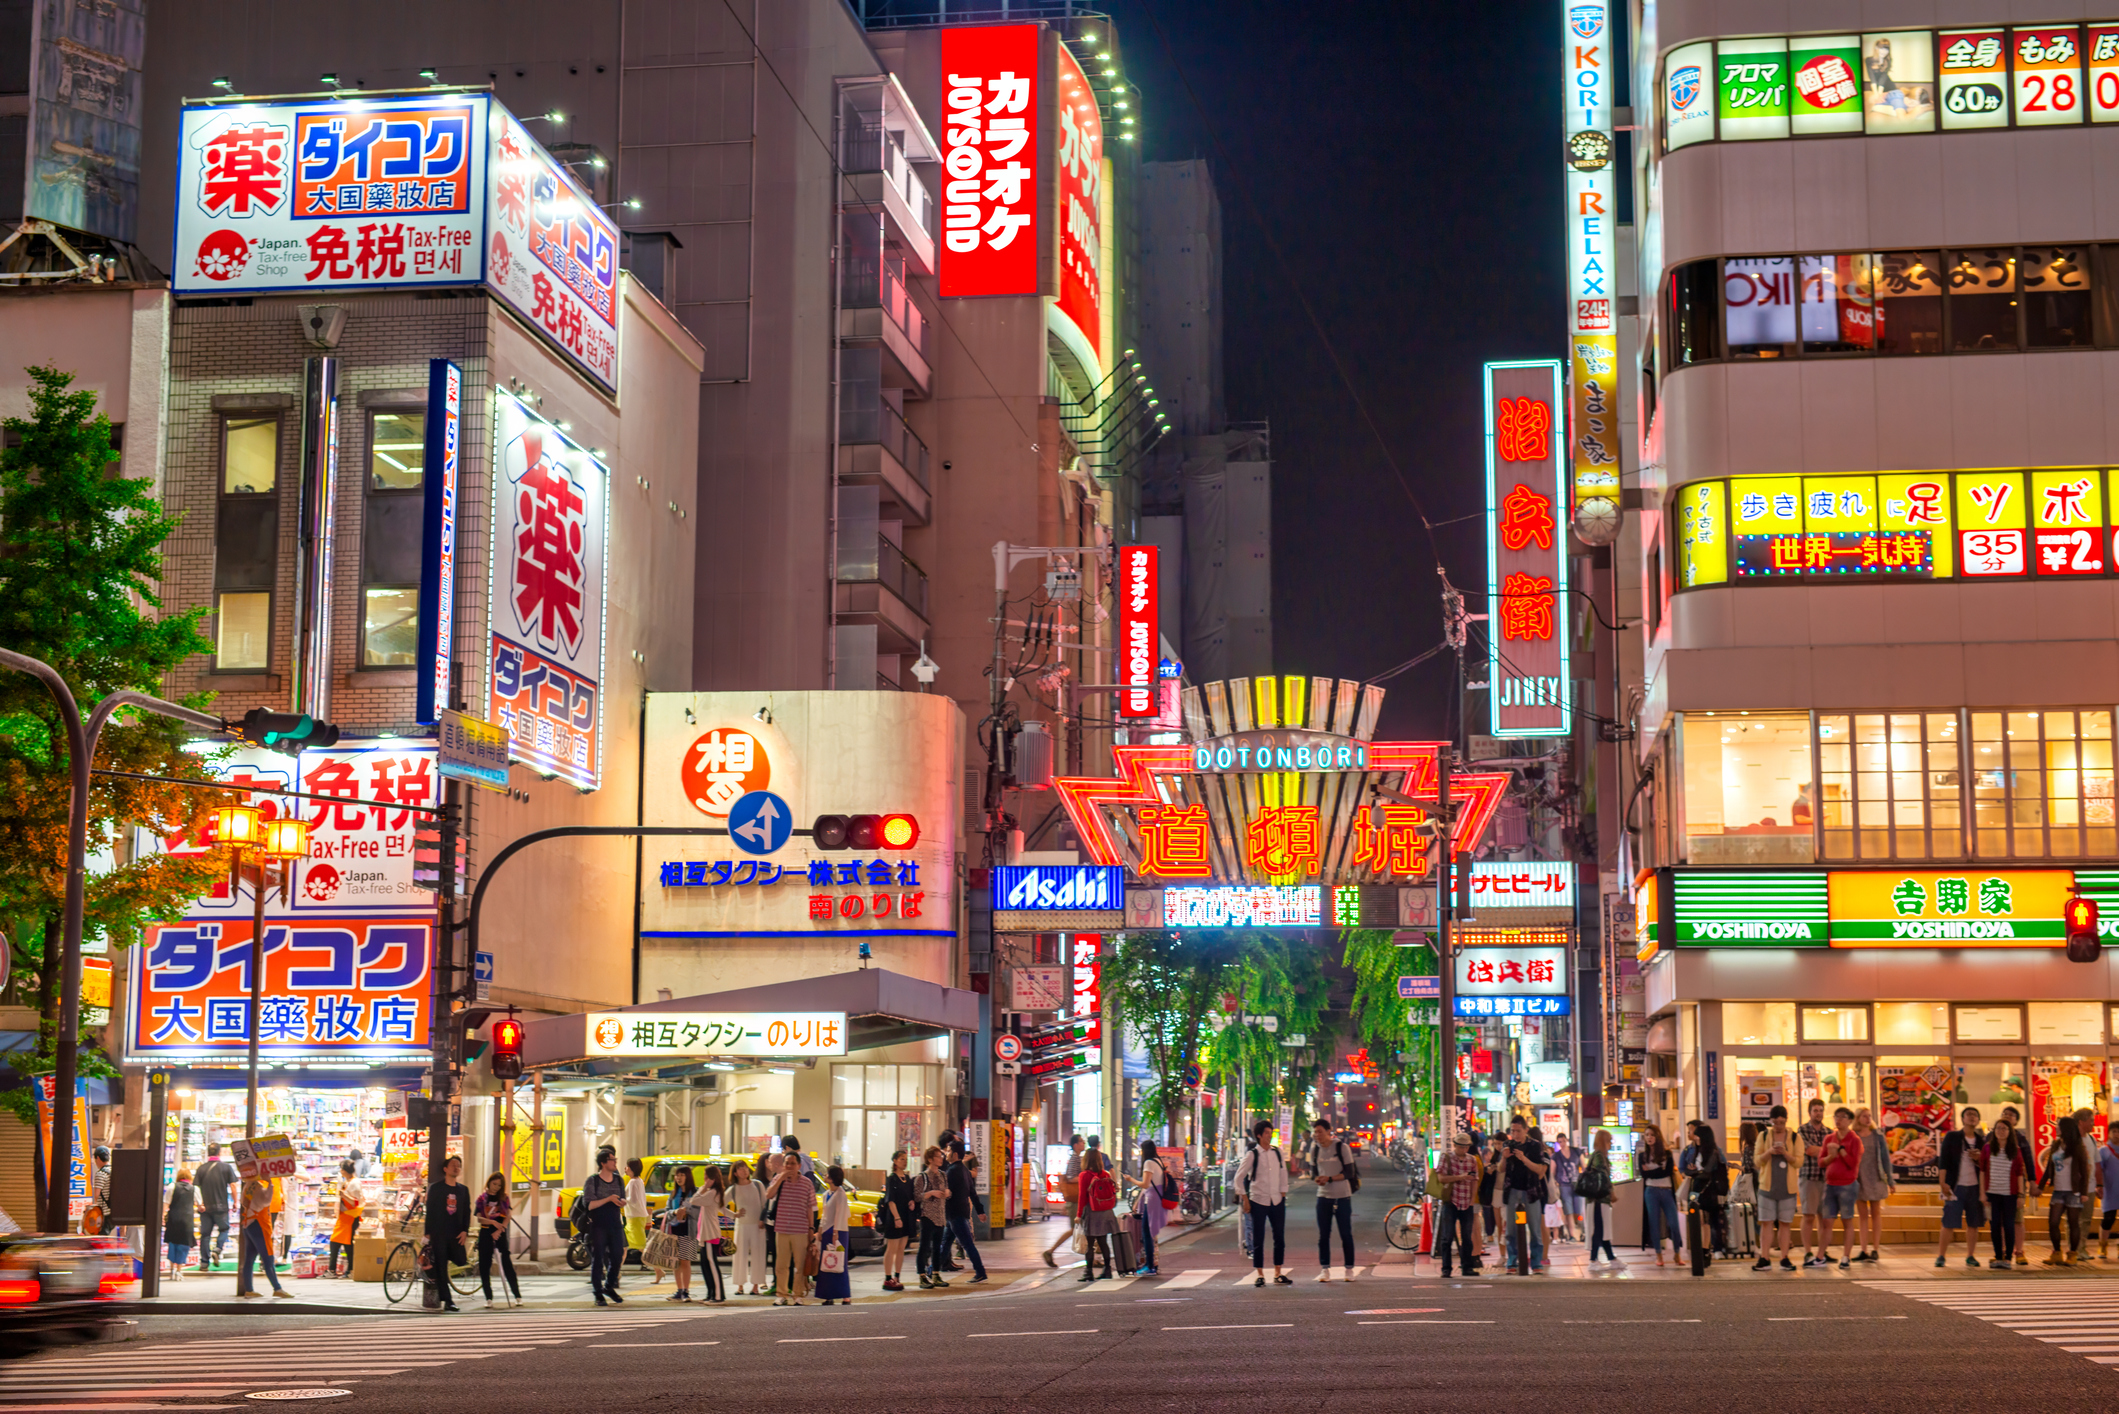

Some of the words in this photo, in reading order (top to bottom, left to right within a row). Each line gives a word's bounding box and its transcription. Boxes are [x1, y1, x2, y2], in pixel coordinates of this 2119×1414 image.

[1943, 37, 2002, 69] 全身
[2018, 35, 2075, 64] もみ
[1722, 63, 1780, 84] アロマ
[1795, 58, 1850, 95] 個室
[1730, 84, 1786, 108] リンパ
[1817, 79, 1858, 107] 完備
[1948, 86, 2000, 112] 60分
[299, 116, 467, 182] ダイコク
[981, 71, 1031, 252] カラオケ
[203, 126, 286, 214] 薬
[946, 74, 983, 253] JOYSOUND
[258, 238, 302, 250] Japan.
[407, 226, 471, 247] Tax-Free
[258, 251, 307, 263] Tax-free
[304, 223, 407, 281] 免税
[414, 249, 462, 275] 면세
[256, 264, 288, 277] Shop
[531, 270, 583, 357] 免税
[1579, 300, 1608, 316] 24H
[583, 316, 615, 360] Tax-Free
[1498, 395, 1555, 641] 治兵衛
[1969, 534, 2017, 556] 35
[1981, 558, 2006, 571] 分
[1131, 551, 1149, 613] カラオケ
[1129, 621, 1149, 712] JOYSOUND
[494, 645, 597, 734] ダイコク
[1195, 747, 1365, 770] DOTONBORI
[304, 757, 432, 832] 免税
[1138, 803, 1429, 879] 道頓堀
[345, 870, 387, 886] Japan.
[659, 860, 921, 888] 相互タクシー株式会社
[1009, 868, 1110, 908] Asahi
[346, 883, 393, 895] Tax-free
[396, 882, 427, 896] Shop
[1891, 877, 2013, 916] 吉野家
[809, 892, 925, 920] 南のりば
[1693, 922, 1812, 939] YOSHINOYA
[1893, 921, 2015, 938] YOSHINOYA
[146, 923, 430, 992] ダイコク
[1467, 959, 1554, 984] 治兵衛
[1074, 940, 1097, 1033] カラオ
